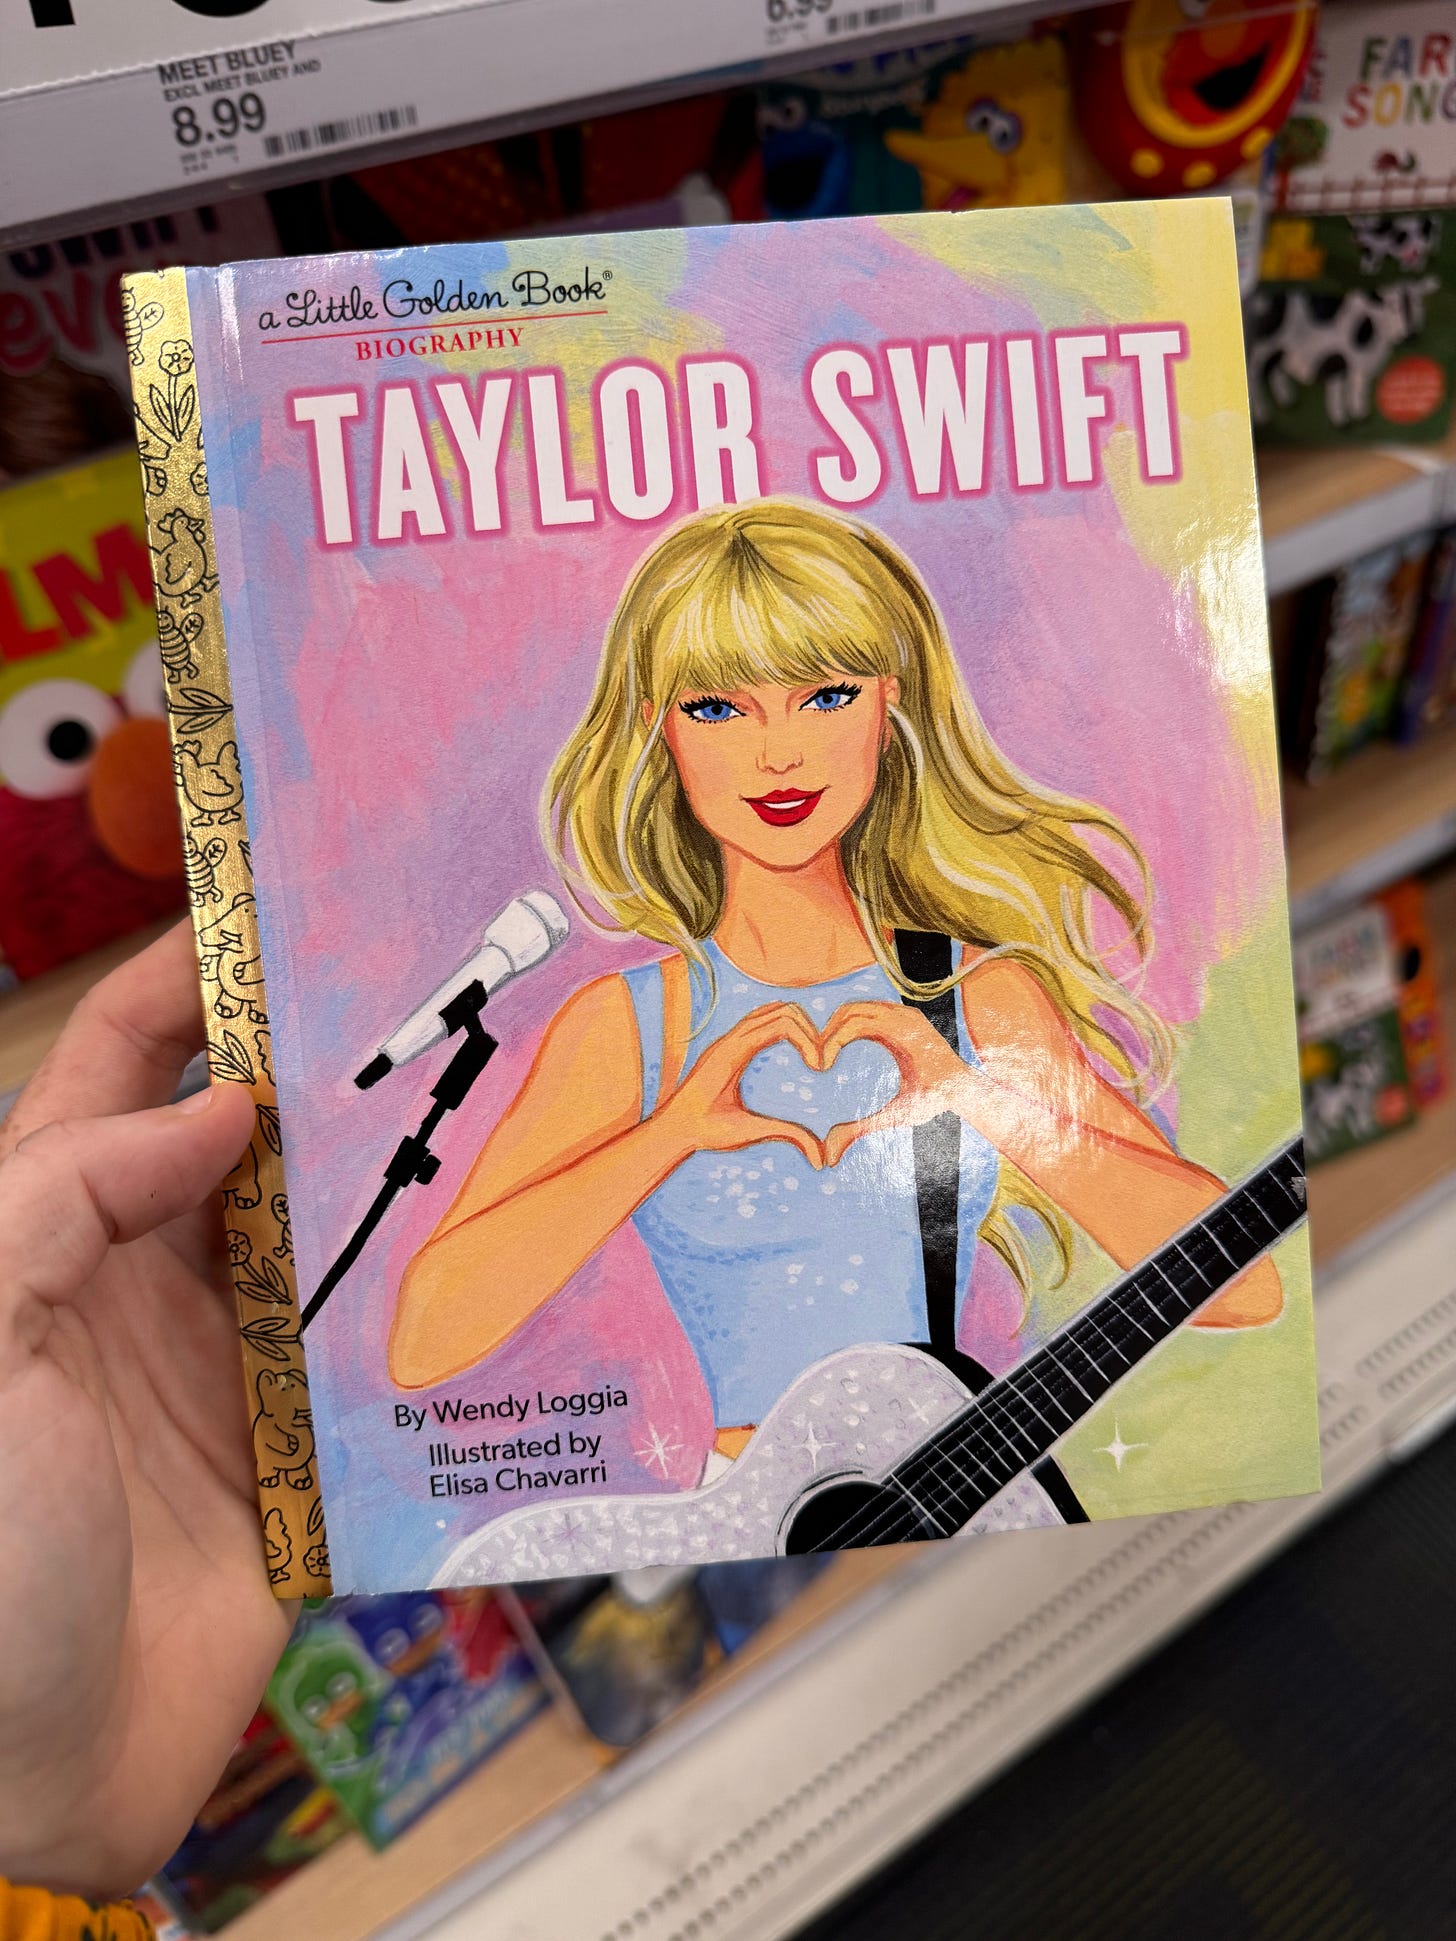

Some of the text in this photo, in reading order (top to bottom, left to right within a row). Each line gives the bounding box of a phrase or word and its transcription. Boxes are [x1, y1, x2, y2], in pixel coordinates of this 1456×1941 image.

[158, 40, 296, 85] MEET BLUEY
[1358, 31, 1456, 80] FAR
[204, 75, 241, 92] MEET
[245, 66, 289, 86] BLUEY
[172, 92, 266, 147] 8.99
[258, 309, 281, 331] a
[286, 286, 379, 328] Little
[383, 279, 508, 318] Golden
[355, 327, 524, 361] BIOGRAPHY
[293, 330, 1182, 545] TAYLOR SWIFT
[394, 1385, 628, 1431] By Wendy Loggia
[429, 1431, 602, 1466] Illustrated by
[430, 1460, 607, 1497] Elisa Chavarri
